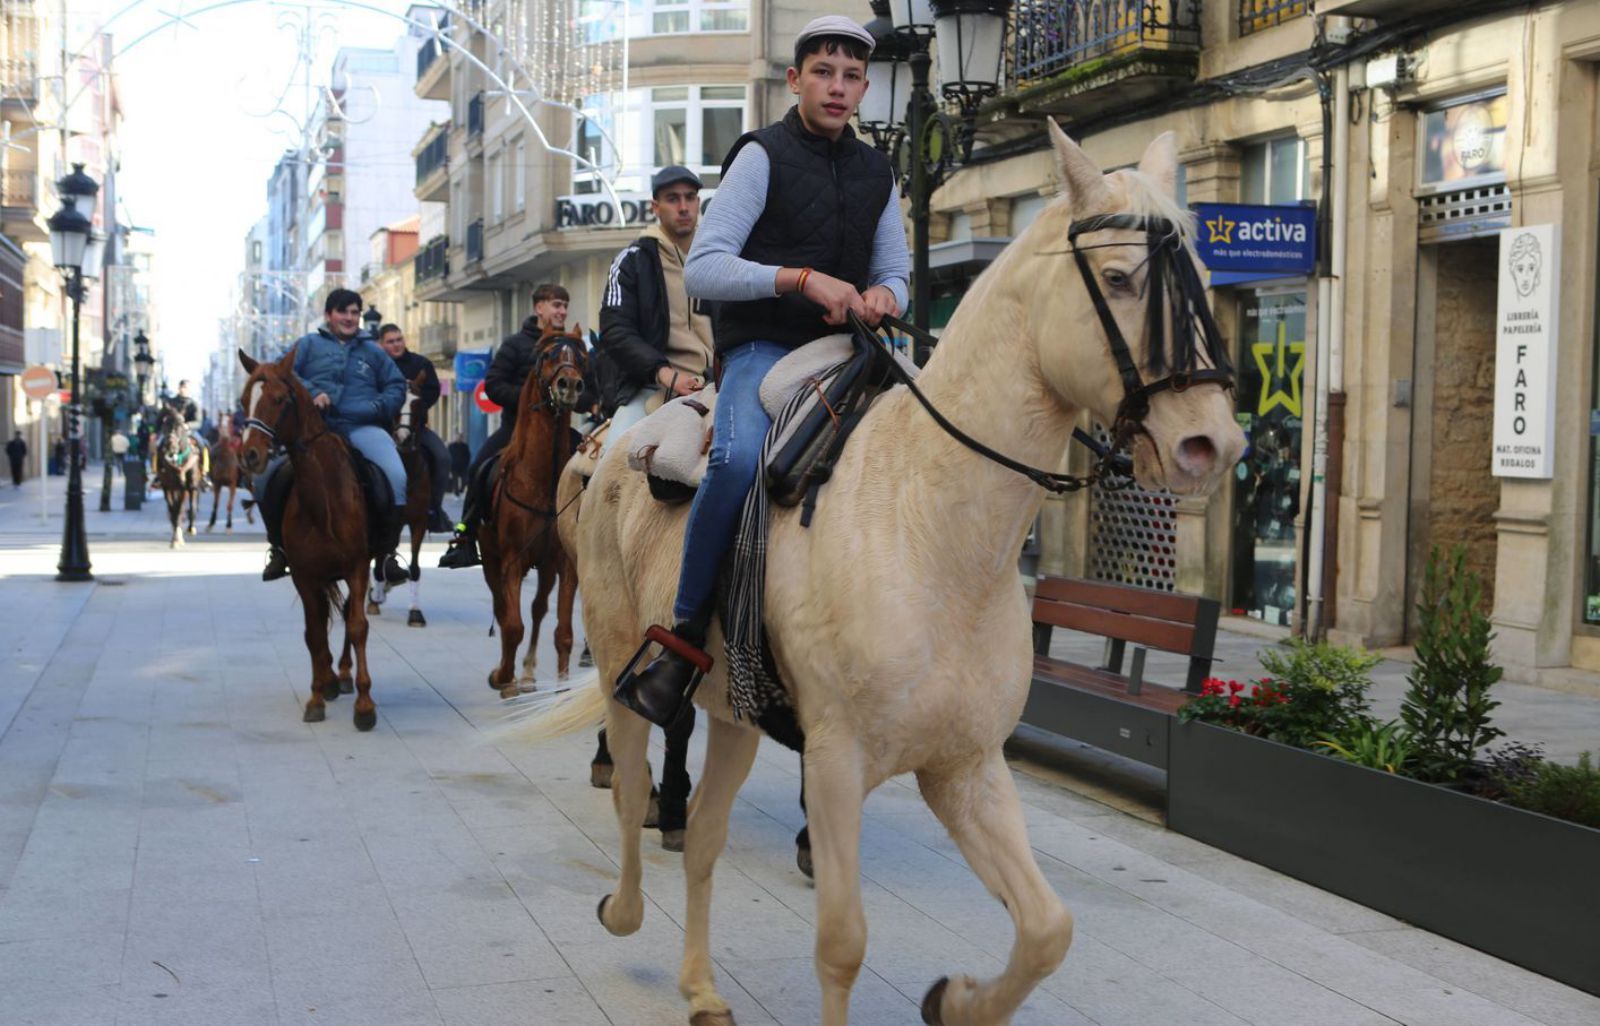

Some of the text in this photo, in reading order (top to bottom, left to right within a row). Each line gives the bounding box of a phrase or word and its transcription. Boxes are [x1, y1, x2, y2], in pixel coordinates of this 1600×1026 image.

[556, 200, 656, 228] FARO DE
[1238, 217, 1306, 242] activa
[1507, 308, 1539, 321] LIBRERÍA
[1503, 322, 1542, 335] PAPELERÍA
[1513, 345, 1527, 435] FARO
[1513, 445, 1541, 455] OFICINA
[1500, 458, 1536, 468] REGALOS
